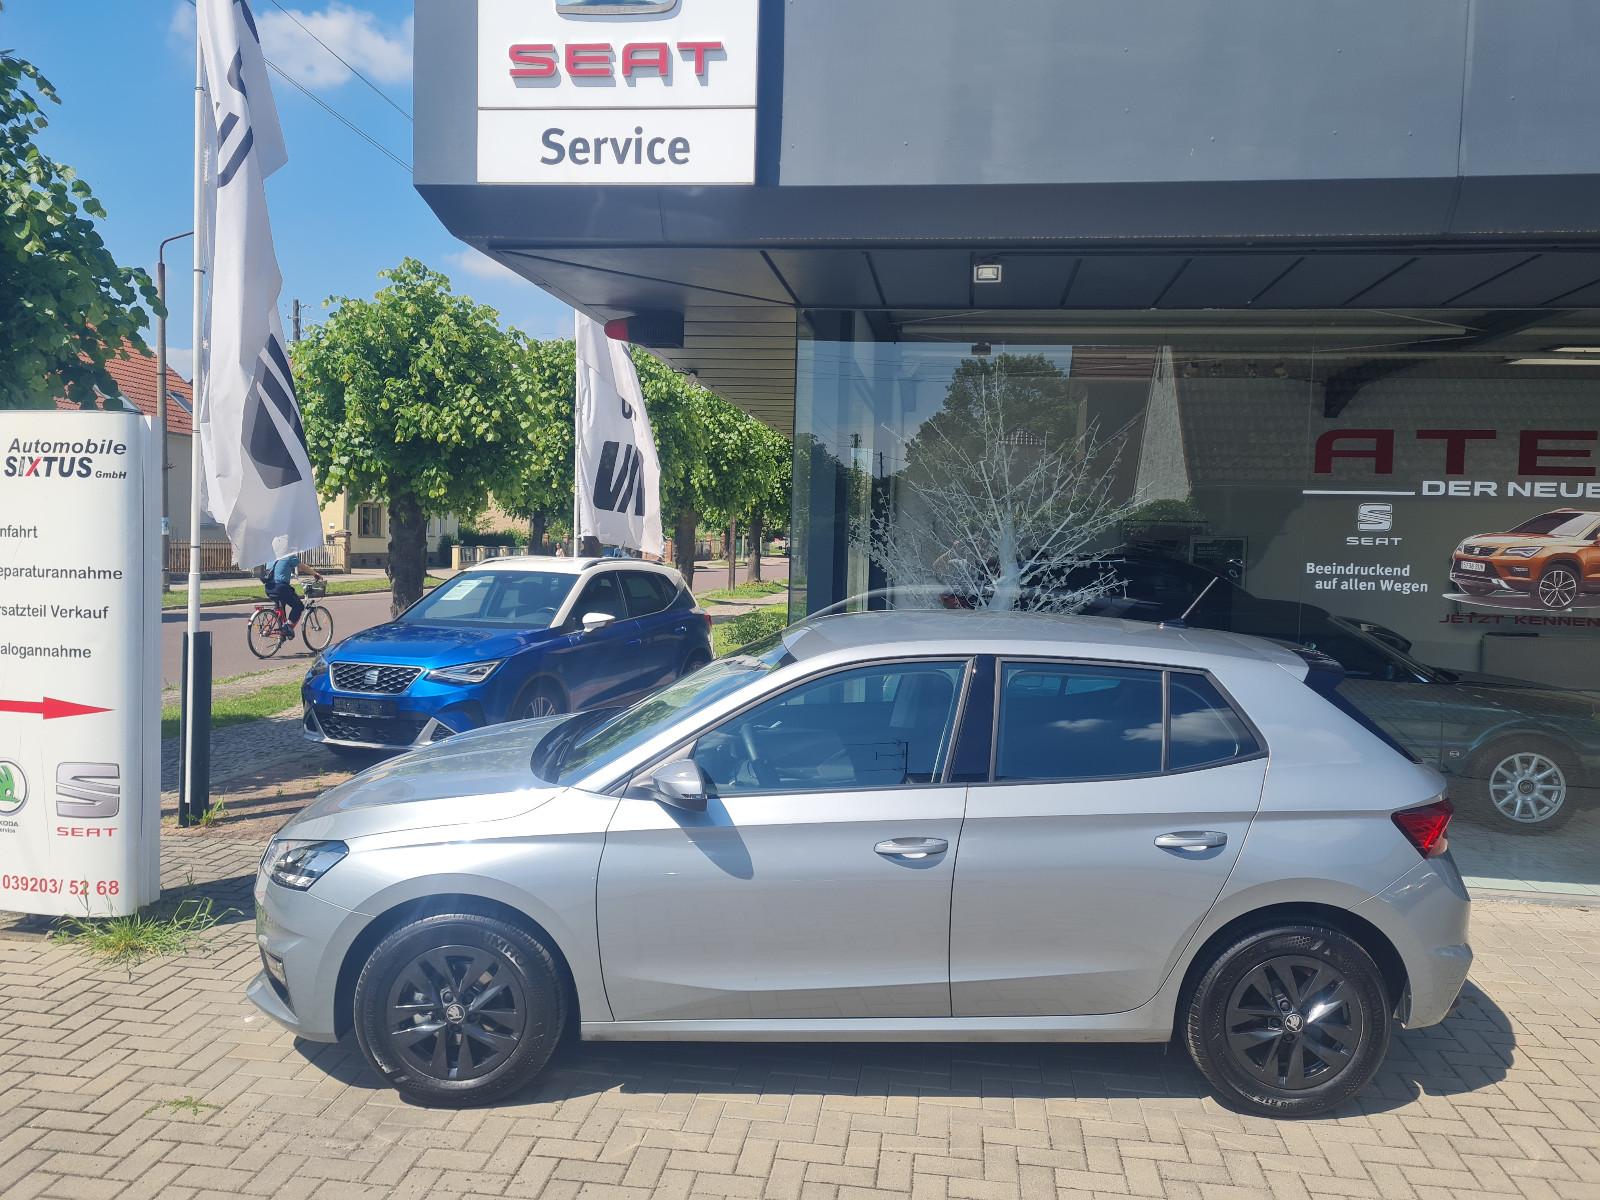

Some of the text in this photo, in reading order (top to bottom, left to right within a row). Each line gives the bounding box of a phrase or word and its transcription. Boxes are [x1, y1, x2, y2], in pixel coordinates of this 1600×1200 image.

[508, 41, 724, 77] SEAT
[540, 126, 691, 165] Service
[8, 438, 127, 455] Automobile
[95, 470, 127, 479] GmbH
[1422, 480, 1498, 497] DER
[1346, 536, 1402, 546] SEAT
[1306, 562, 1411, 577] Beeindruckend
[1315, 579, 1429, 595] auf allen Wegen
[50, 605, 110, 619] Verkauf
[1439, 613, 1504, 624] JETZT
[56, 827, 118, 837] SEAT
[2, 874, 119, 895] 039203/ 52 68
